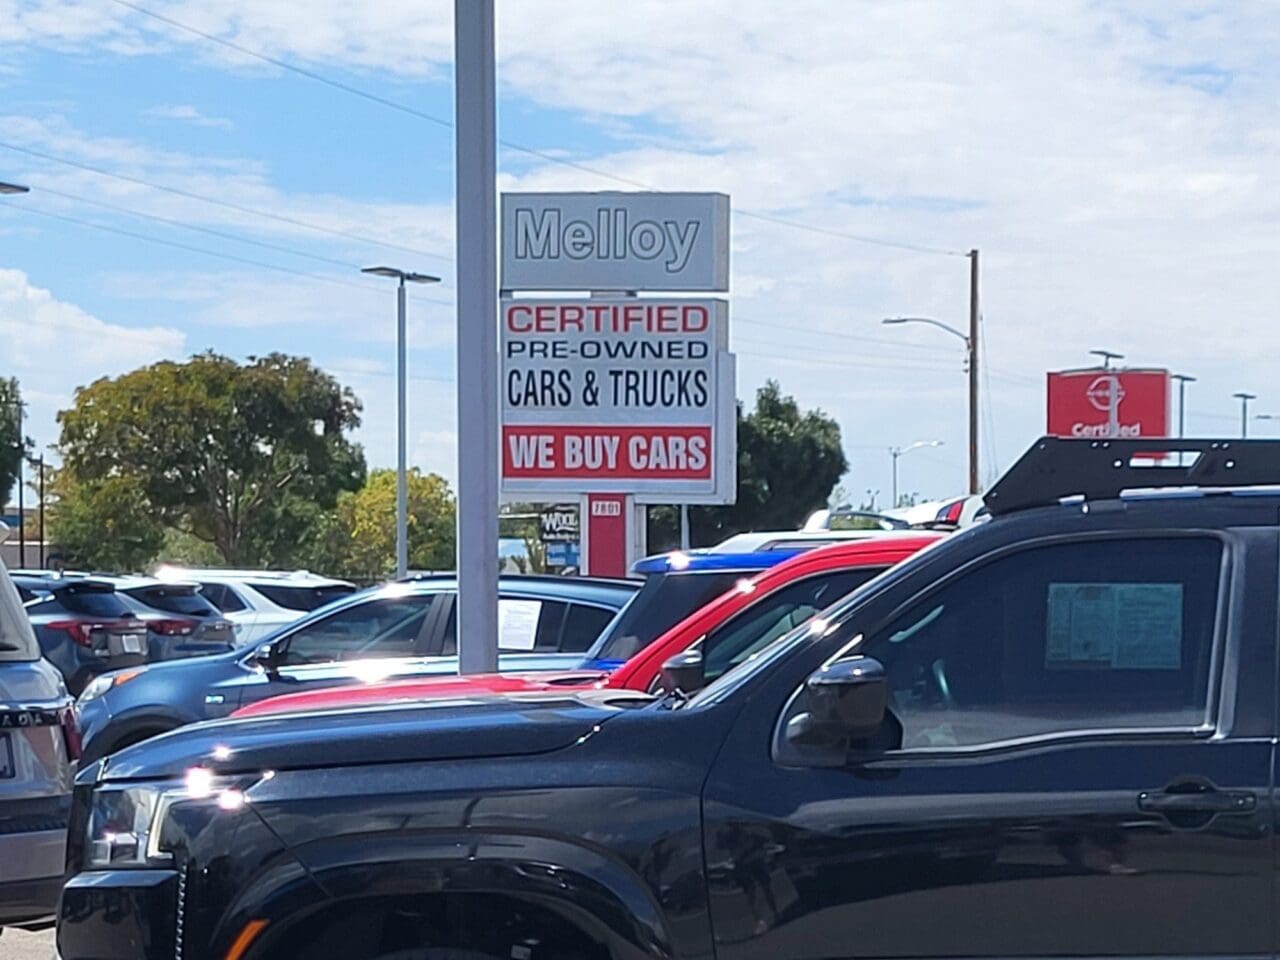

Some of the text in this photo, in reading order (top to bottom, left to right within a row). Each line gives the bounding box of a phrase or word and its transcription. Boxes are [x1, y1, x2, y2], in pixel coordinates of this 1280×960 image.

[514, 208, 700, 273] Melloy
[506, 304, 709, 334] CERTIFIED
[506, 340, 708, 360] PRE-OWNED
[507, 369, 708, 407] CARS & TRUCKS
[508, 435, 707, 470] WE BUY CARS
